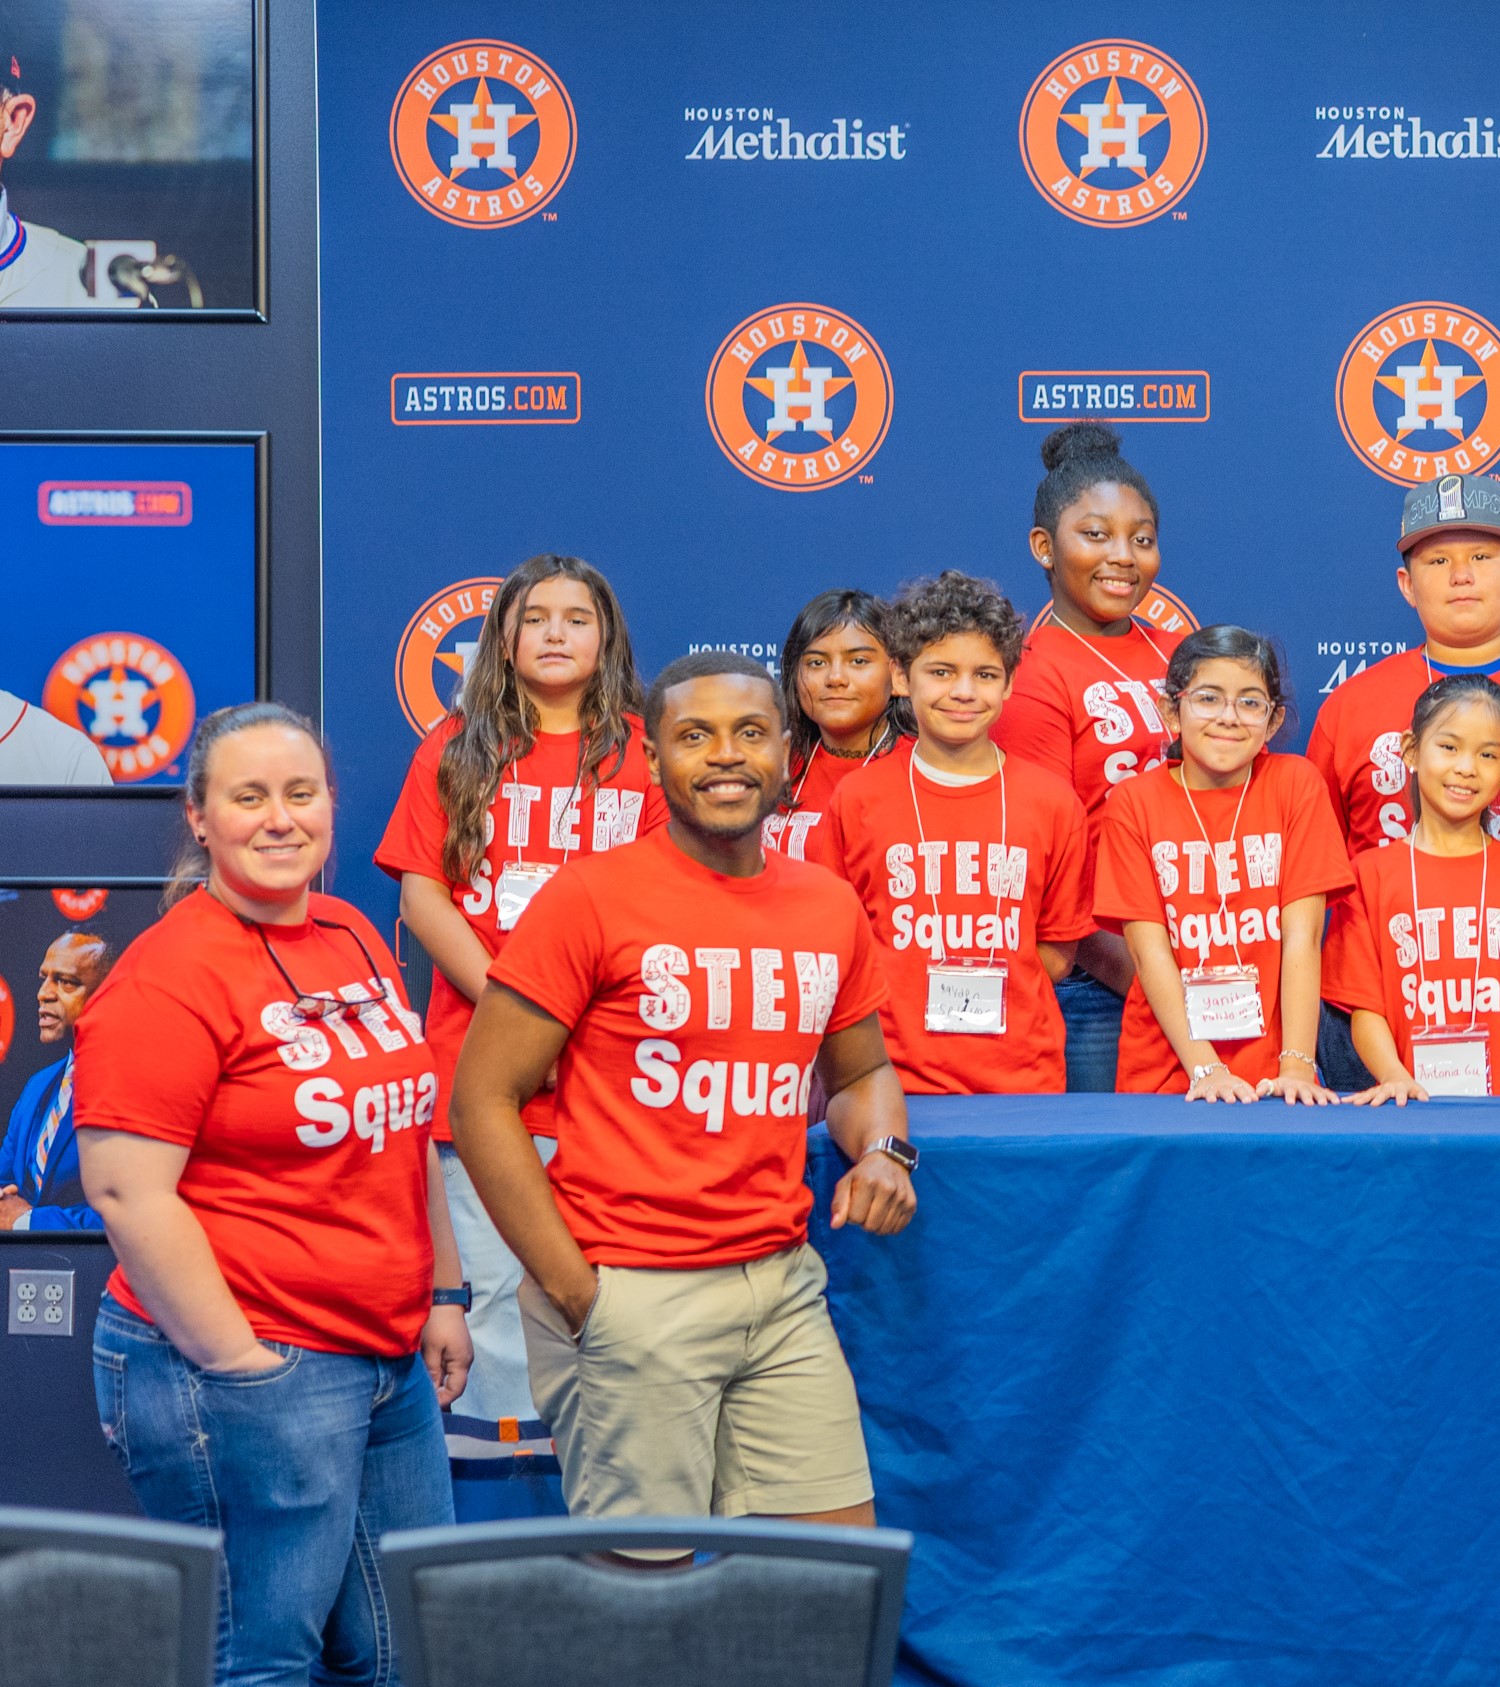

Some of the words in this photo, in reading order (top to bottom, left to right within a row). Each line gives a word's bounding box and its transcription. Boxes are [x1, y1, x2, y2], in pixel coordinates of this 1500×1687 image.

[415, 51, 551, 100] HOUSTON
[1045, 51, 1182, 100] HOUSTON
[450, 103, 516, 169] H
[685, 108, 774, 121] HOUSTON
[1080, 103, 1146, 168] H
[1315, 106, 1405, 120] HOUSTON
[685, 118, 906, 160] Methodist
[422, 175, 543, 216] ASTROS
[1052, 174, 1173, 215] ASTROS
[731, 315, 867, 364] HOUSTON
[1362, 313, 1498, 362] HOUSTON
[405, 386, 567, 411] ASTROS.COM
[766, 367, 832, 431] H
[1032, 384, 1196, 409] ASTROS.COM
[1397, 365, 1463, 430] H
[738, 438, 859, 479] ASTROS
[1368, 436, 1490, 478] ASTROS
[420, 589, 494, 642] HOUS
[1318, 642, 1406, 655] HOUSTON
[885, 840, 1028, 901] STEM
[1151, 832, 1282, 898] STEM
[891, 904, 1021, 960] Squad
[638, 943, 839, 1035] STEM
[1417, 1063, 1459, 1081] Antonia
[294, 1072, 438, 1154] Squa
